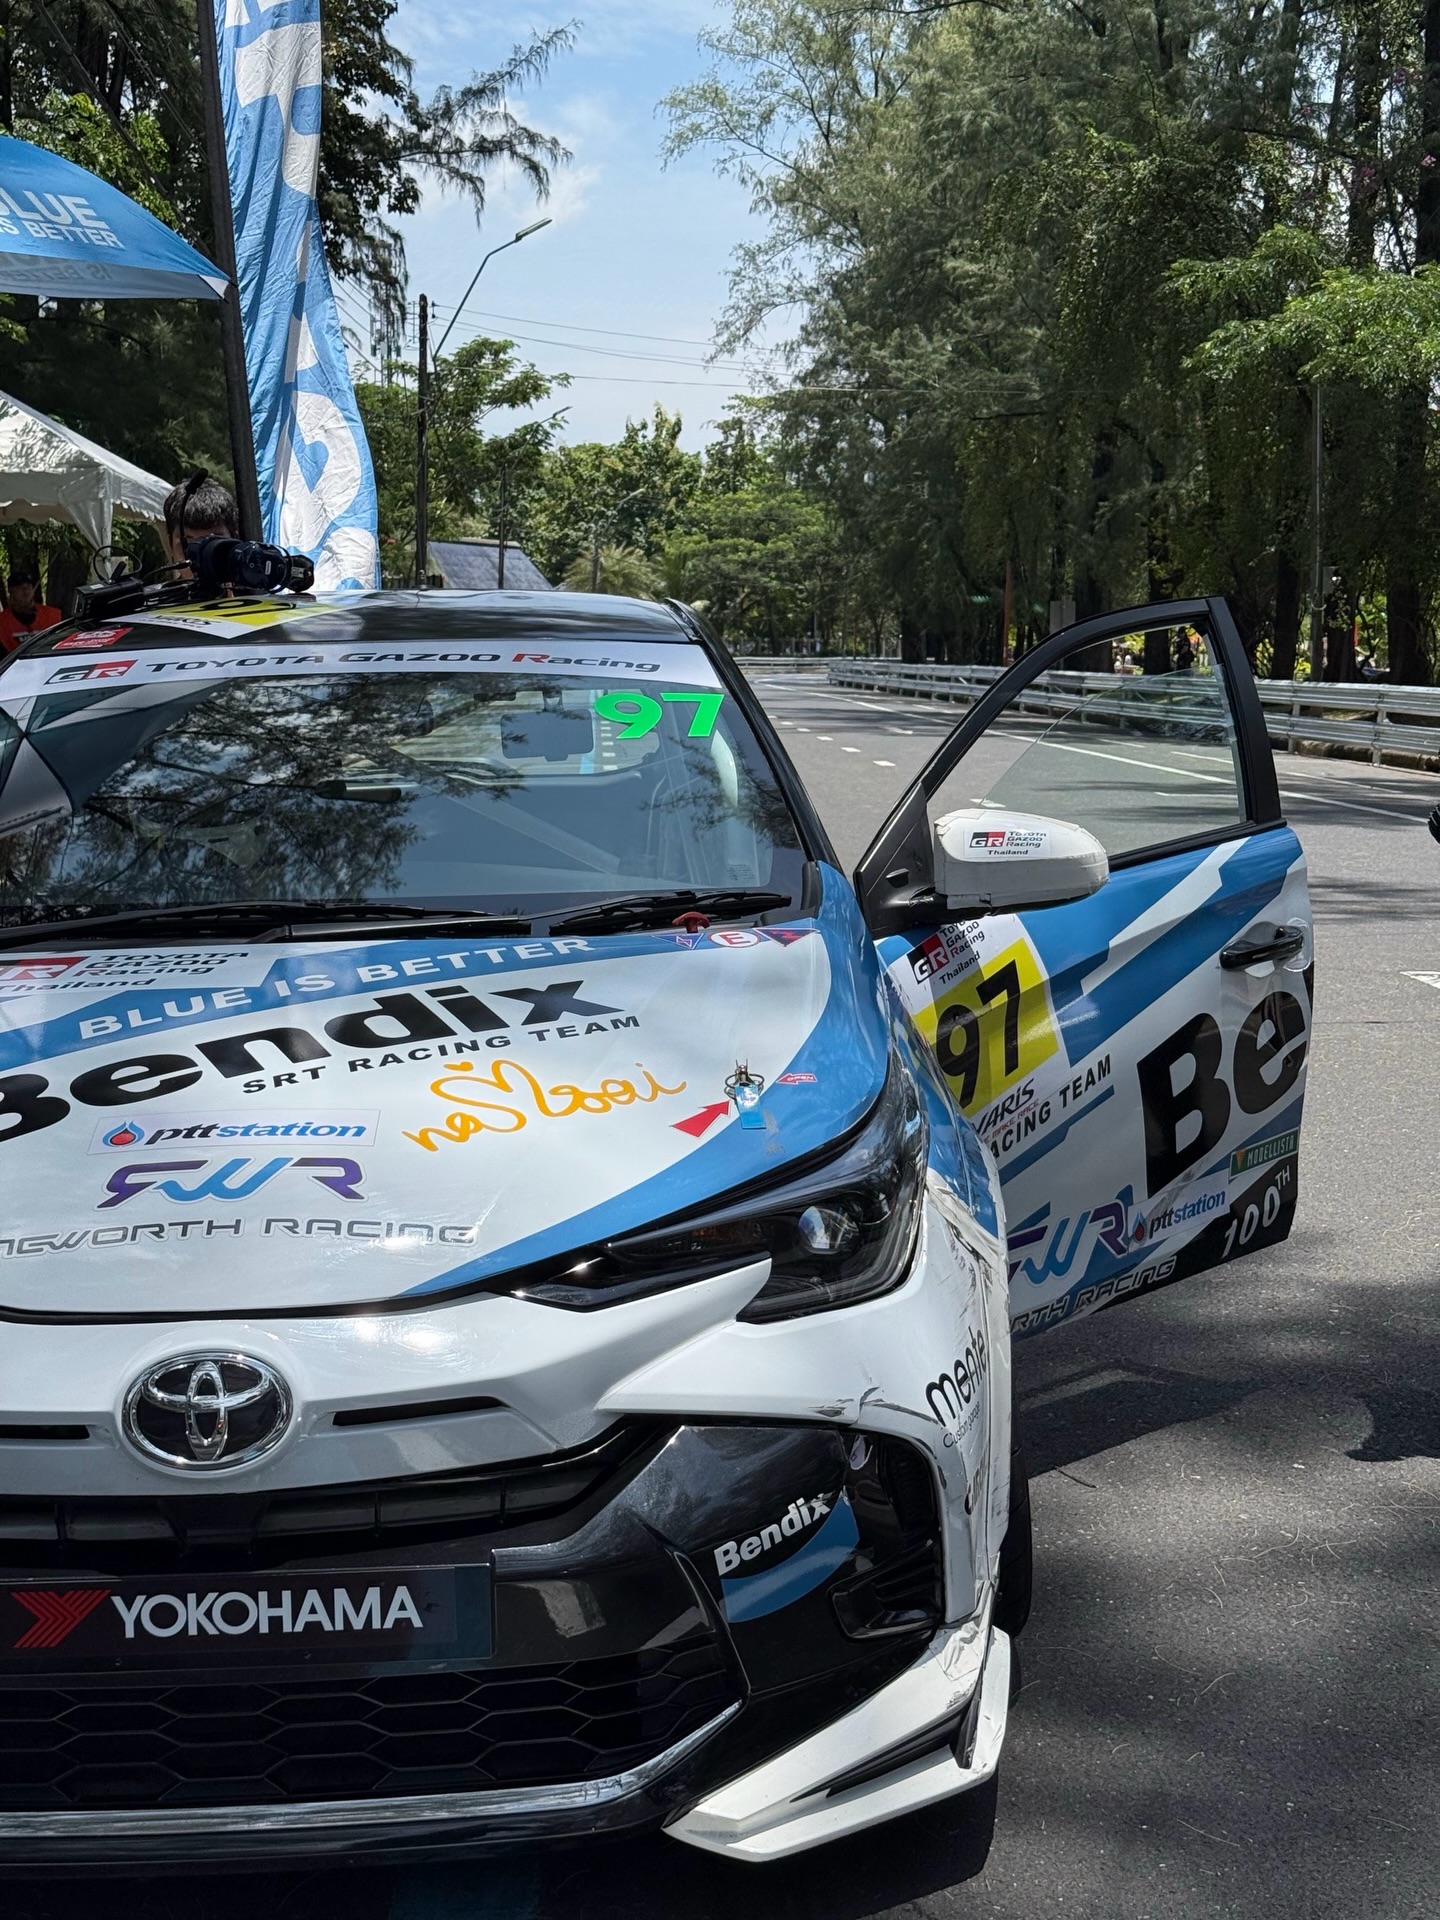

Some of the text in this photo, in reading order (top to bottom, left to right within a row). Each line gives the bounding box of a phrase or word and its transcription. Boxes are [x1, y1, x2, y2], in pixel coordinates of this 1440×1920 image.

[22, 220, 125, 249] BETTER
[145, 654, 326, 673] TOYOTA
[338, 652, 500, 663] GAZOO
[513, 652, 661, 673] Racing
[594, 692, 726, 739] 97
[946, 921, 980, 948] GAZOO
[950, 930, 985, 958] Racing
[72, 966, 216, 978] Racing
[85, 959, 230, 970] GAZOO
[101, 952, 250, 962] TOYOTA
[939, 951, 981, 984] Thailand
[80, 938, 596, 1040] BLUE IS BETTER
[936, 959, 1020, 1111] 97
[242, 1014, 642, 1093] SRT RACING TEAM
[990, 1054, 1111, 1159] ACING TEAM
[1246, 1134, 1295, 1167] MODELLISTA
[264, 1218, 478, 1246] RACING
[1074, 1256, 1177, 1311] RACING
[714, 1493, 832, 1577] Bendix
[110, 1585, 425, 1638] YOKOHAMA
